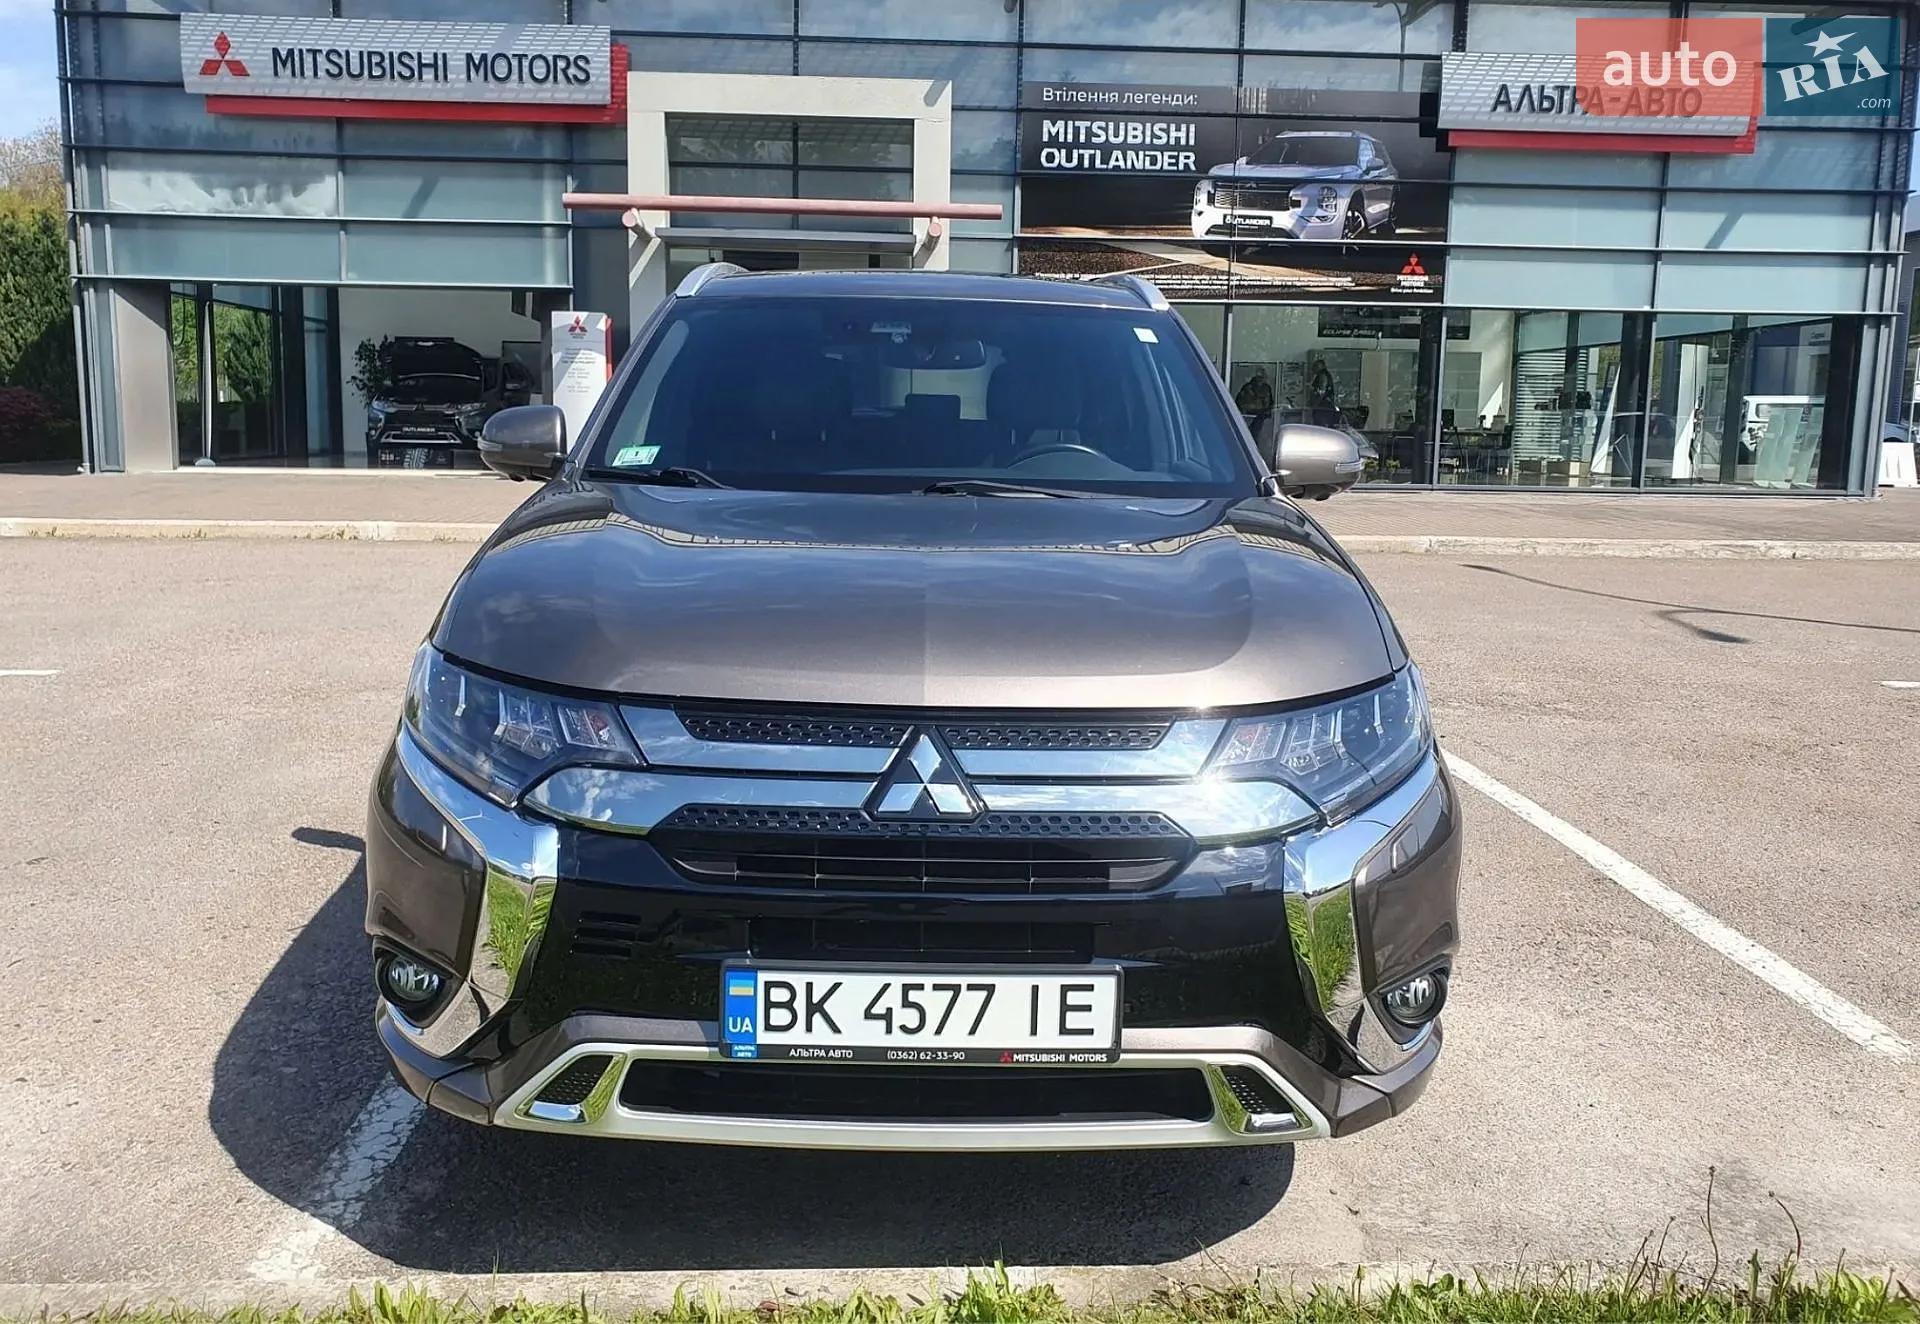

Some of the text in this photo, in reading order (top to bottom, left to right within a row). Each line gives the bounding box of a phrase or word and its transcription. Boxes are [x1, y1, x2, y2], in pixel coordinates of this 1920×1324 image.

[271, 47, 592, 85] MITSUBISHI MOTORS
[1043, 87, 1198, 107] Втілення легенди:
[1490, 83, 1704, 119] АЛЬТРА-АВТО
[1042, 119, 1196, 146] MITSUBISHI
[1040, 147, 1197, 171] OUTLANDER
[763, 980, 1095, 1037] BK 4577 IE
[728, 1016, 754, 1033] UA
[789, 1048, 853, 1058] АЛЬТРА АВТО
[887, 1050, 965, 1060] (0362) 62-33-90
[1013, 1053, 1108, 1063] MITSUBISHI MOTORS
